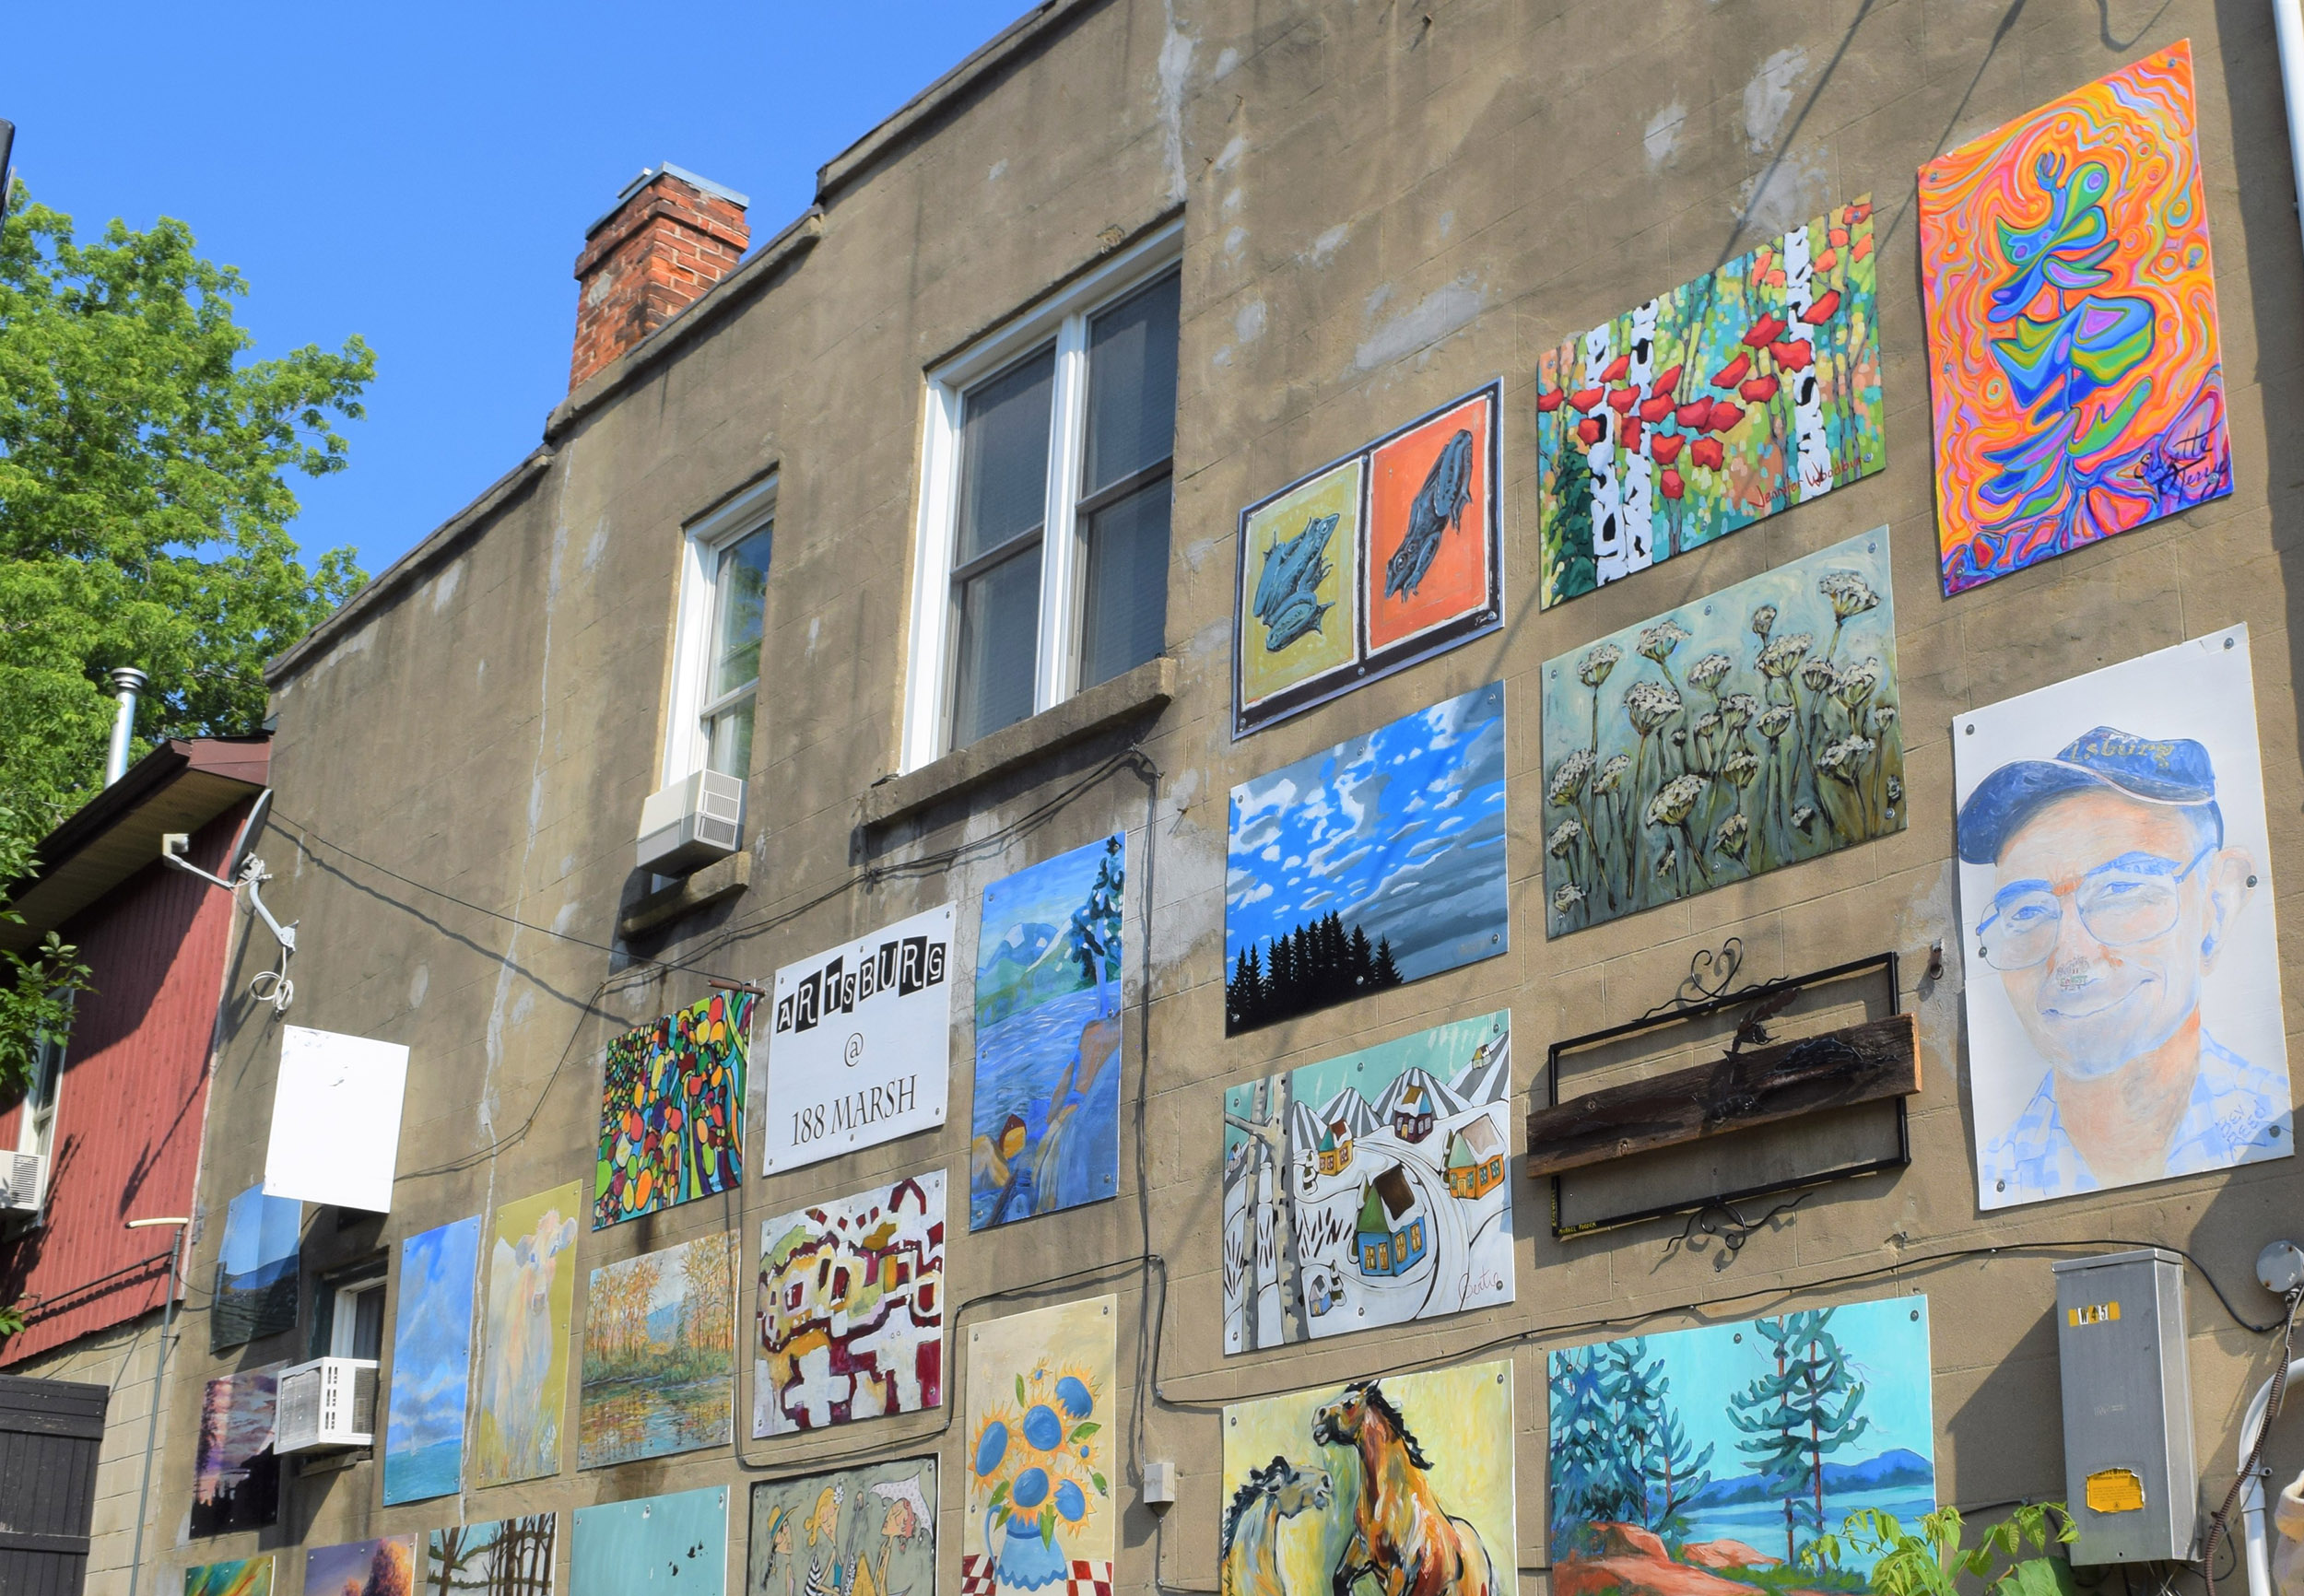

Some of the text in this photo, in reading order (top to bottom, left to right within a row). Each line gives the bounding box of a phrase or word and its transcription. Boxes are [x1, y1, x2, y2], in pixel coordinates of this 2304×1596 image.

[778, 939, 945, 1032] ARTSBURG
[843, 1032, 864, 1067] @
[792, 1074, 918, 1146] 188 MARSH
